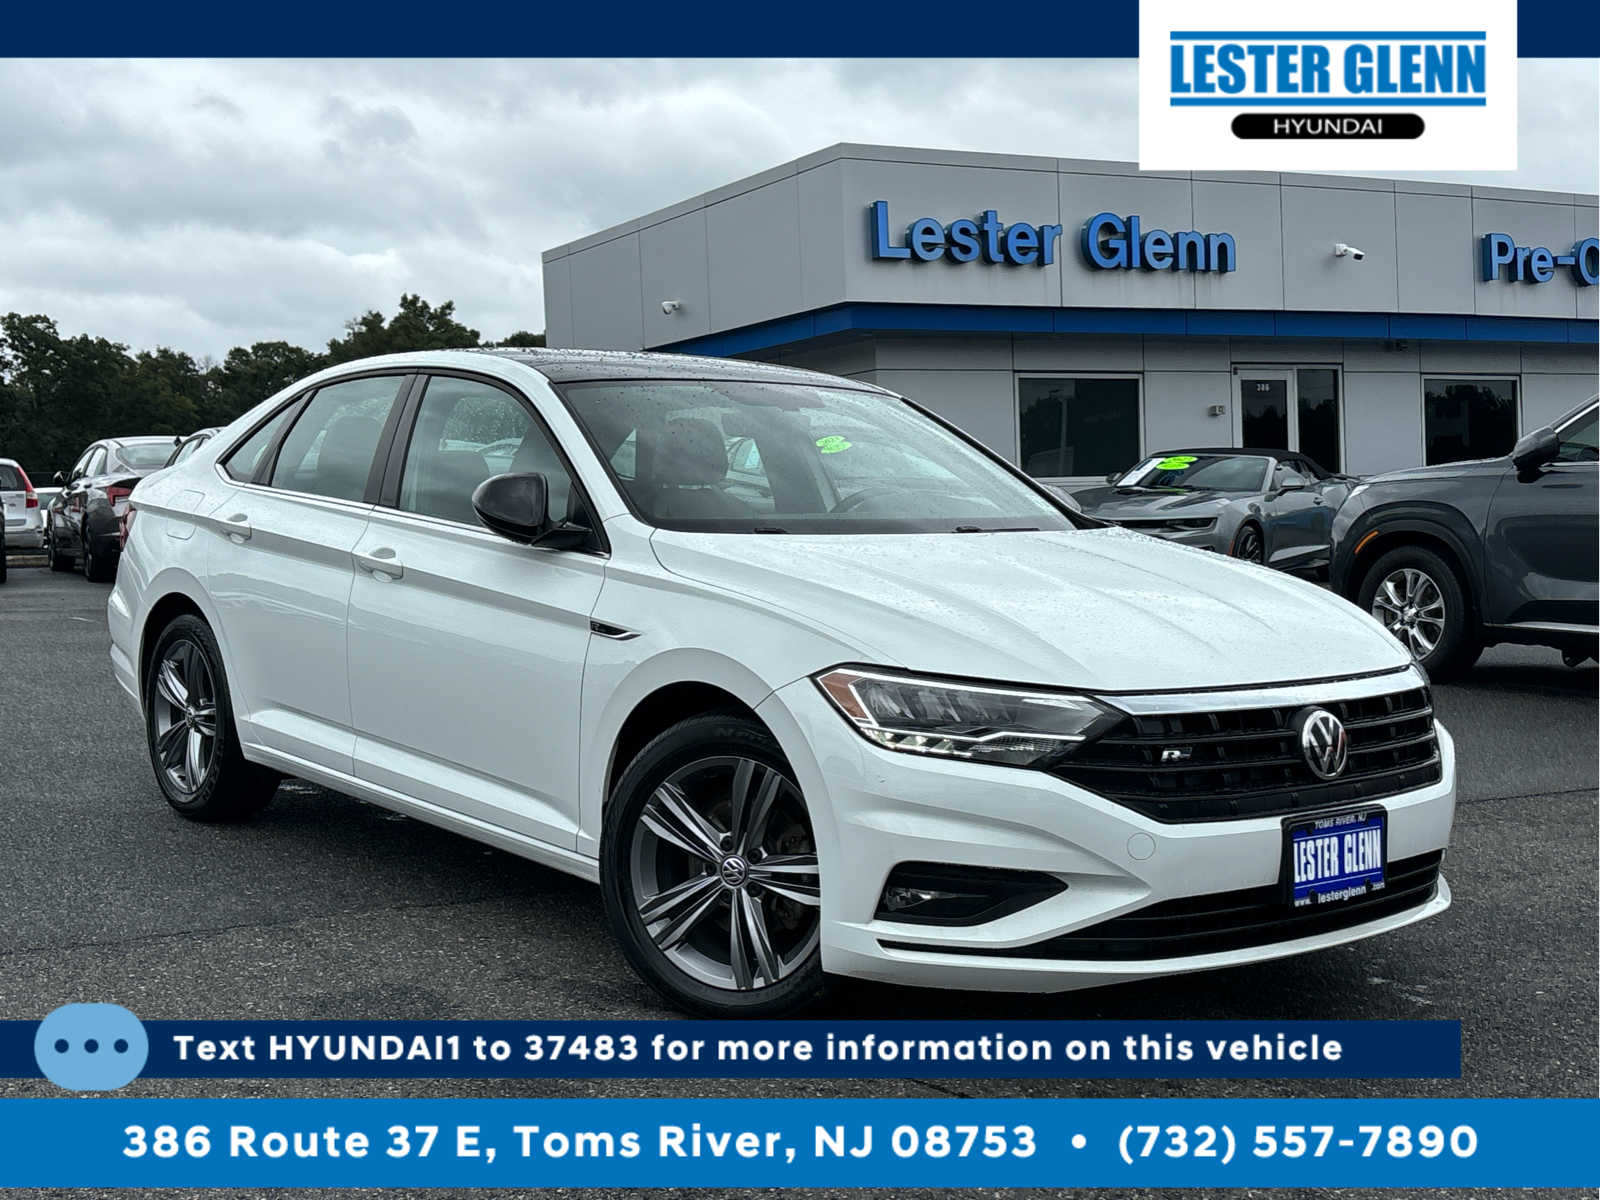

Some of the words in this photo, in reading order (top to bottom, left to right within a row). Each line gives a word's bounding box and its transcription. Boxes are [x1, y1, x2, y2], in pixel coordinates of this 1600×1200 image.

[871, 200, 1063, 266] Lester
[1082, 211, 1237, 273] Glenn
[1314, 818, 1334, 830] TOMS
[1293, 836, 1339, 884] LESTER
[1344, 829, 1381, 874] GLENN
[1317, 885, 1367, 904] lesterglenn
